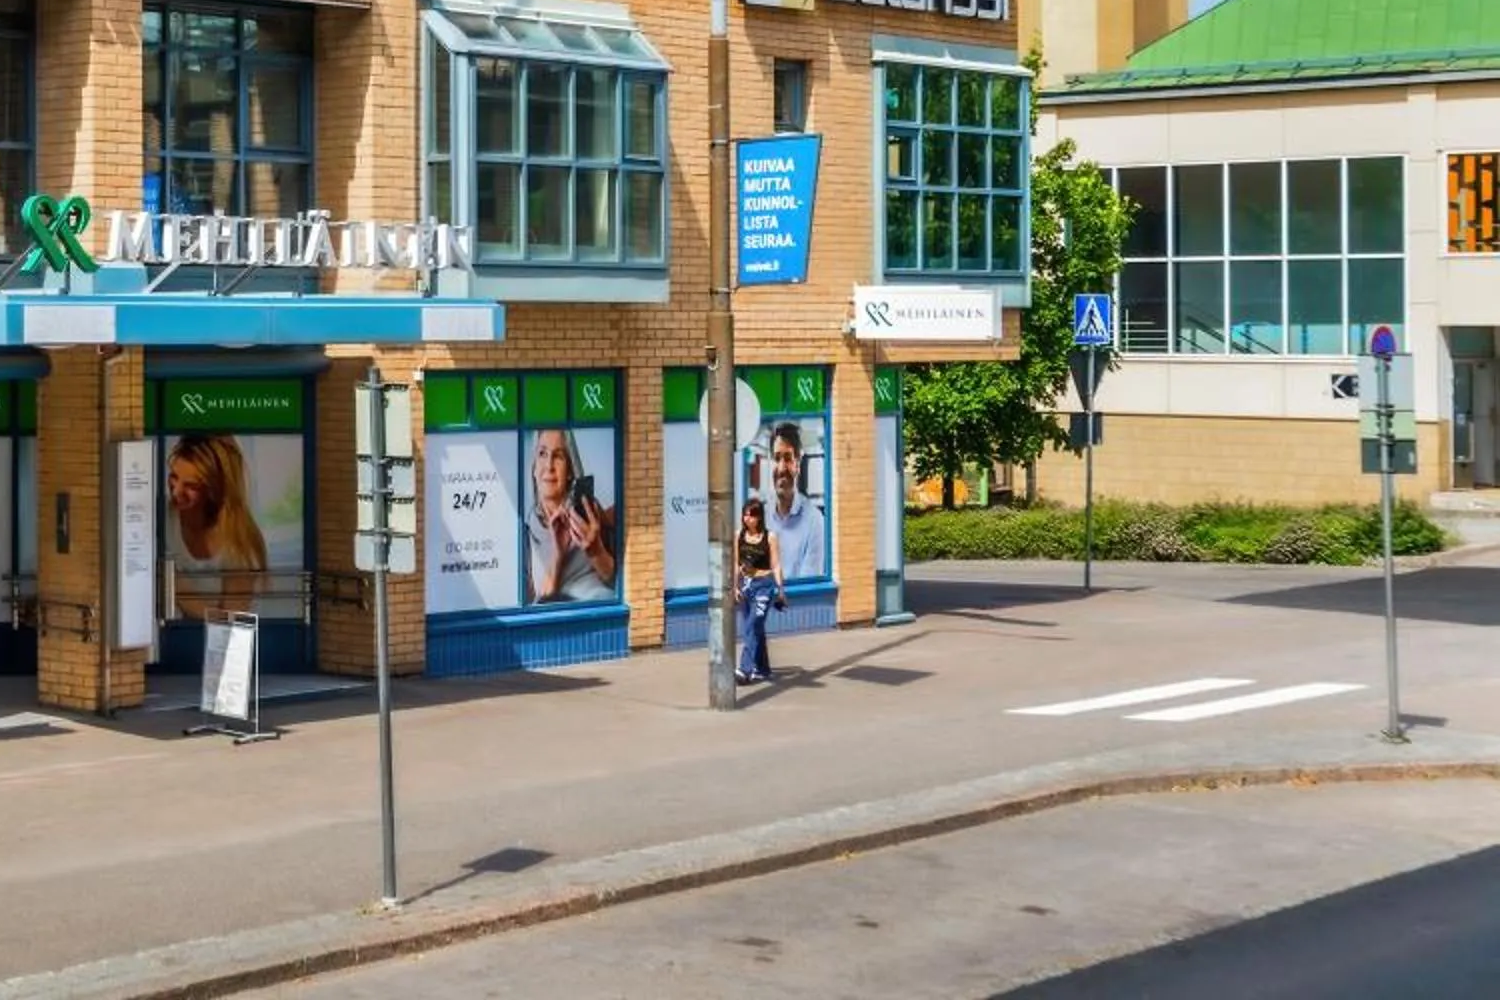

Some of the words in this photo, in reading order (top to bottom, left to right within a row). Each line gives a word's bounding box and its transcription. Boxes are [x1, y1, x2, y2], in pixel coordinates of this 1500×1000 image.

[744, 158, 795, 174] KUIVAA
[744, 177, 792, 193] MUTTA
[744, 196, 803, 211] KUNNOL-
[744, 215, 779, 230] LISTA
[105, 208, 475, 272] MEHILÄINEN
[744, 233, 797, 249] SEURAA.
[452, 490, 487, 510] 24/7
